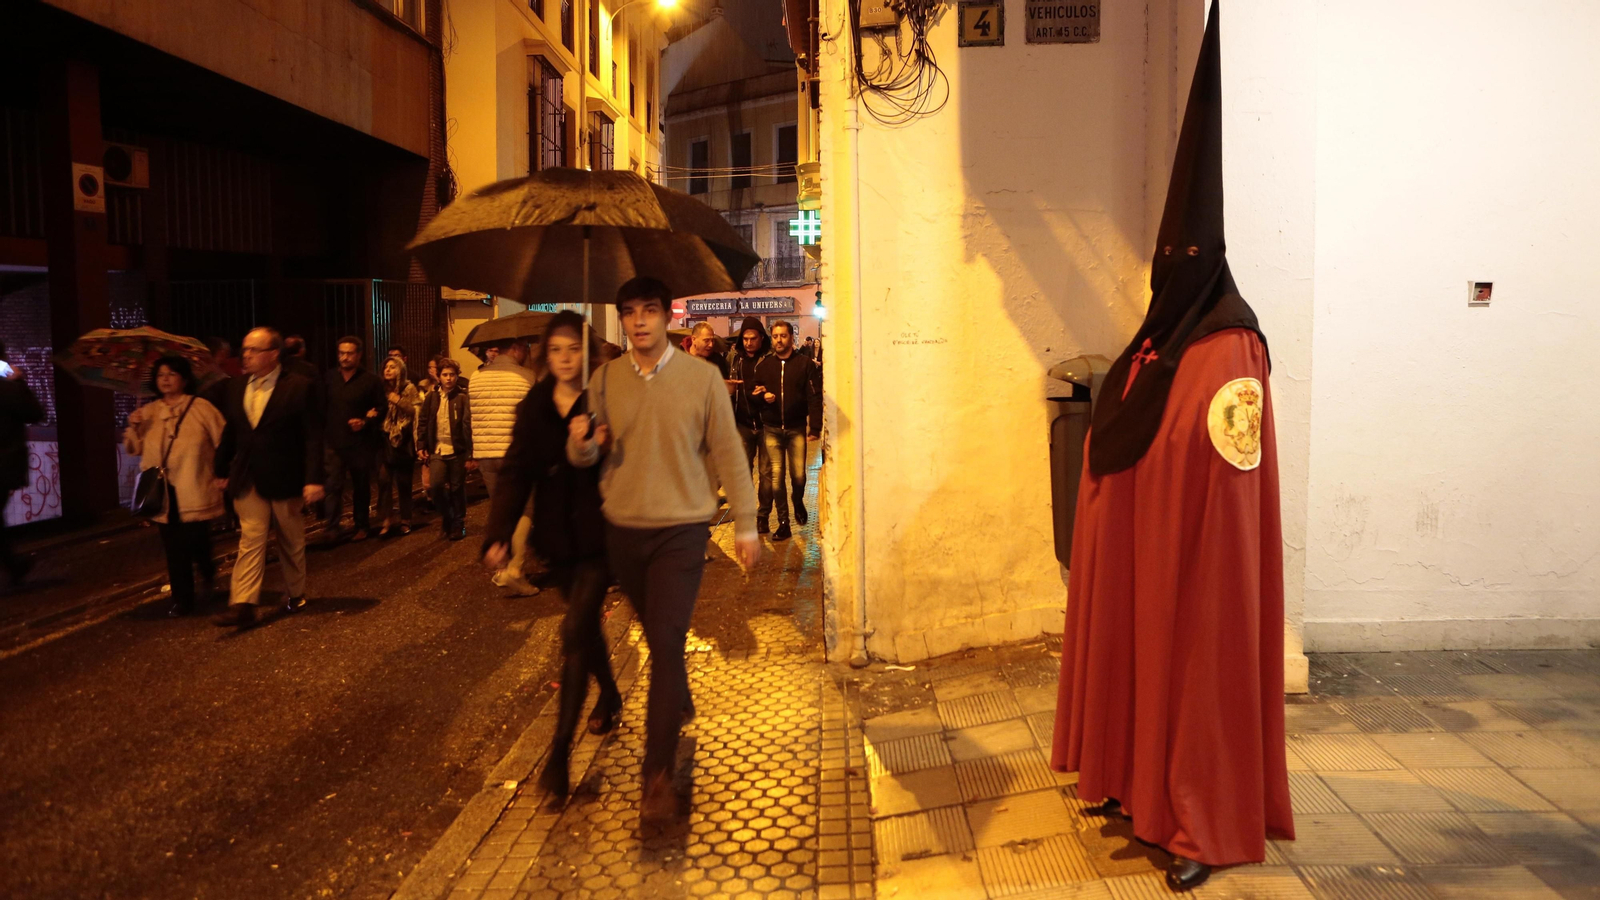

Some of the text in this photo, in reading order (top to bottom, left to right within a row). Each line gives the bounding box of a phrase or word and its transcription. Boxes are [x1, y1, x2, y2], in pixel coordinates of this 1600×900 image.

[1029, 5, 1096, 19] VEHICULOS
[973, 9, 990, 36] 4
[691, 302, 732, 311] CERVECERIA
[740, 302, 749, 310] LA
